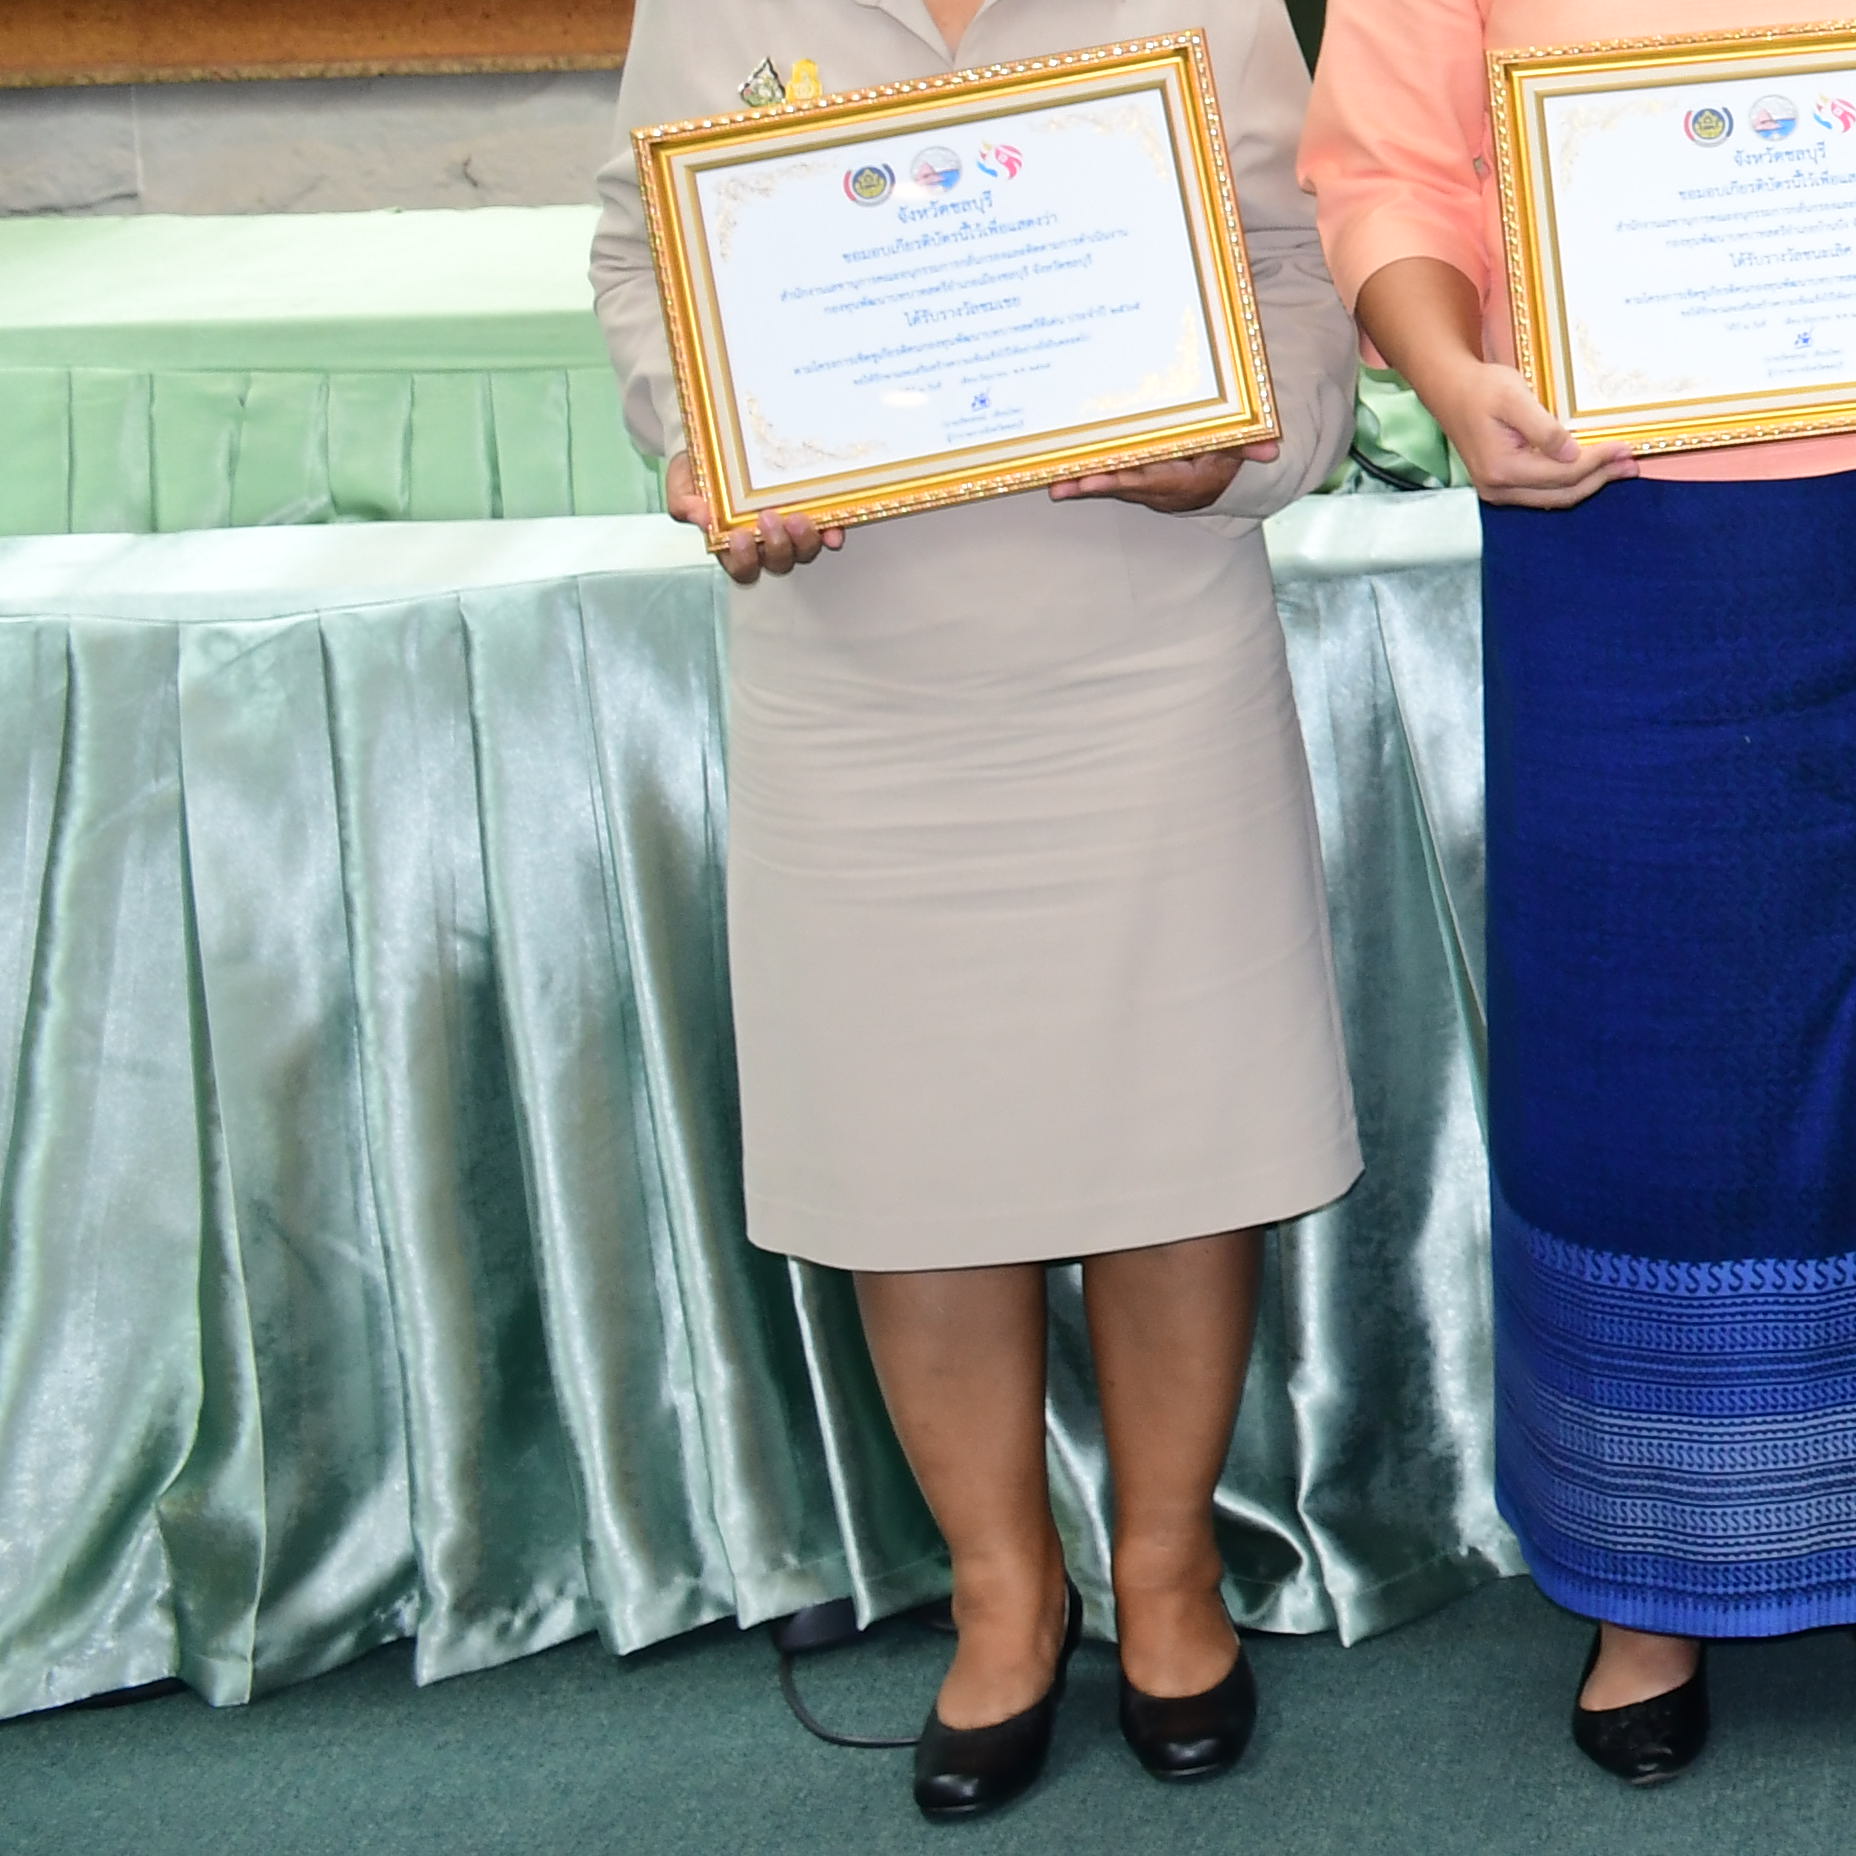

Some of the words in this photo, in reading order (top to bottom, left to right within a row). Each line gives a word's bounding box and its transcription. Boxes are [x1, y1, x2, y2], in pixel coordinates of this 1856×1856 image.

[1733, 140, 1826, 167] จังหวัดชลบุรี
[897, 189, 993, 224] จังหวัดชลบุรี
